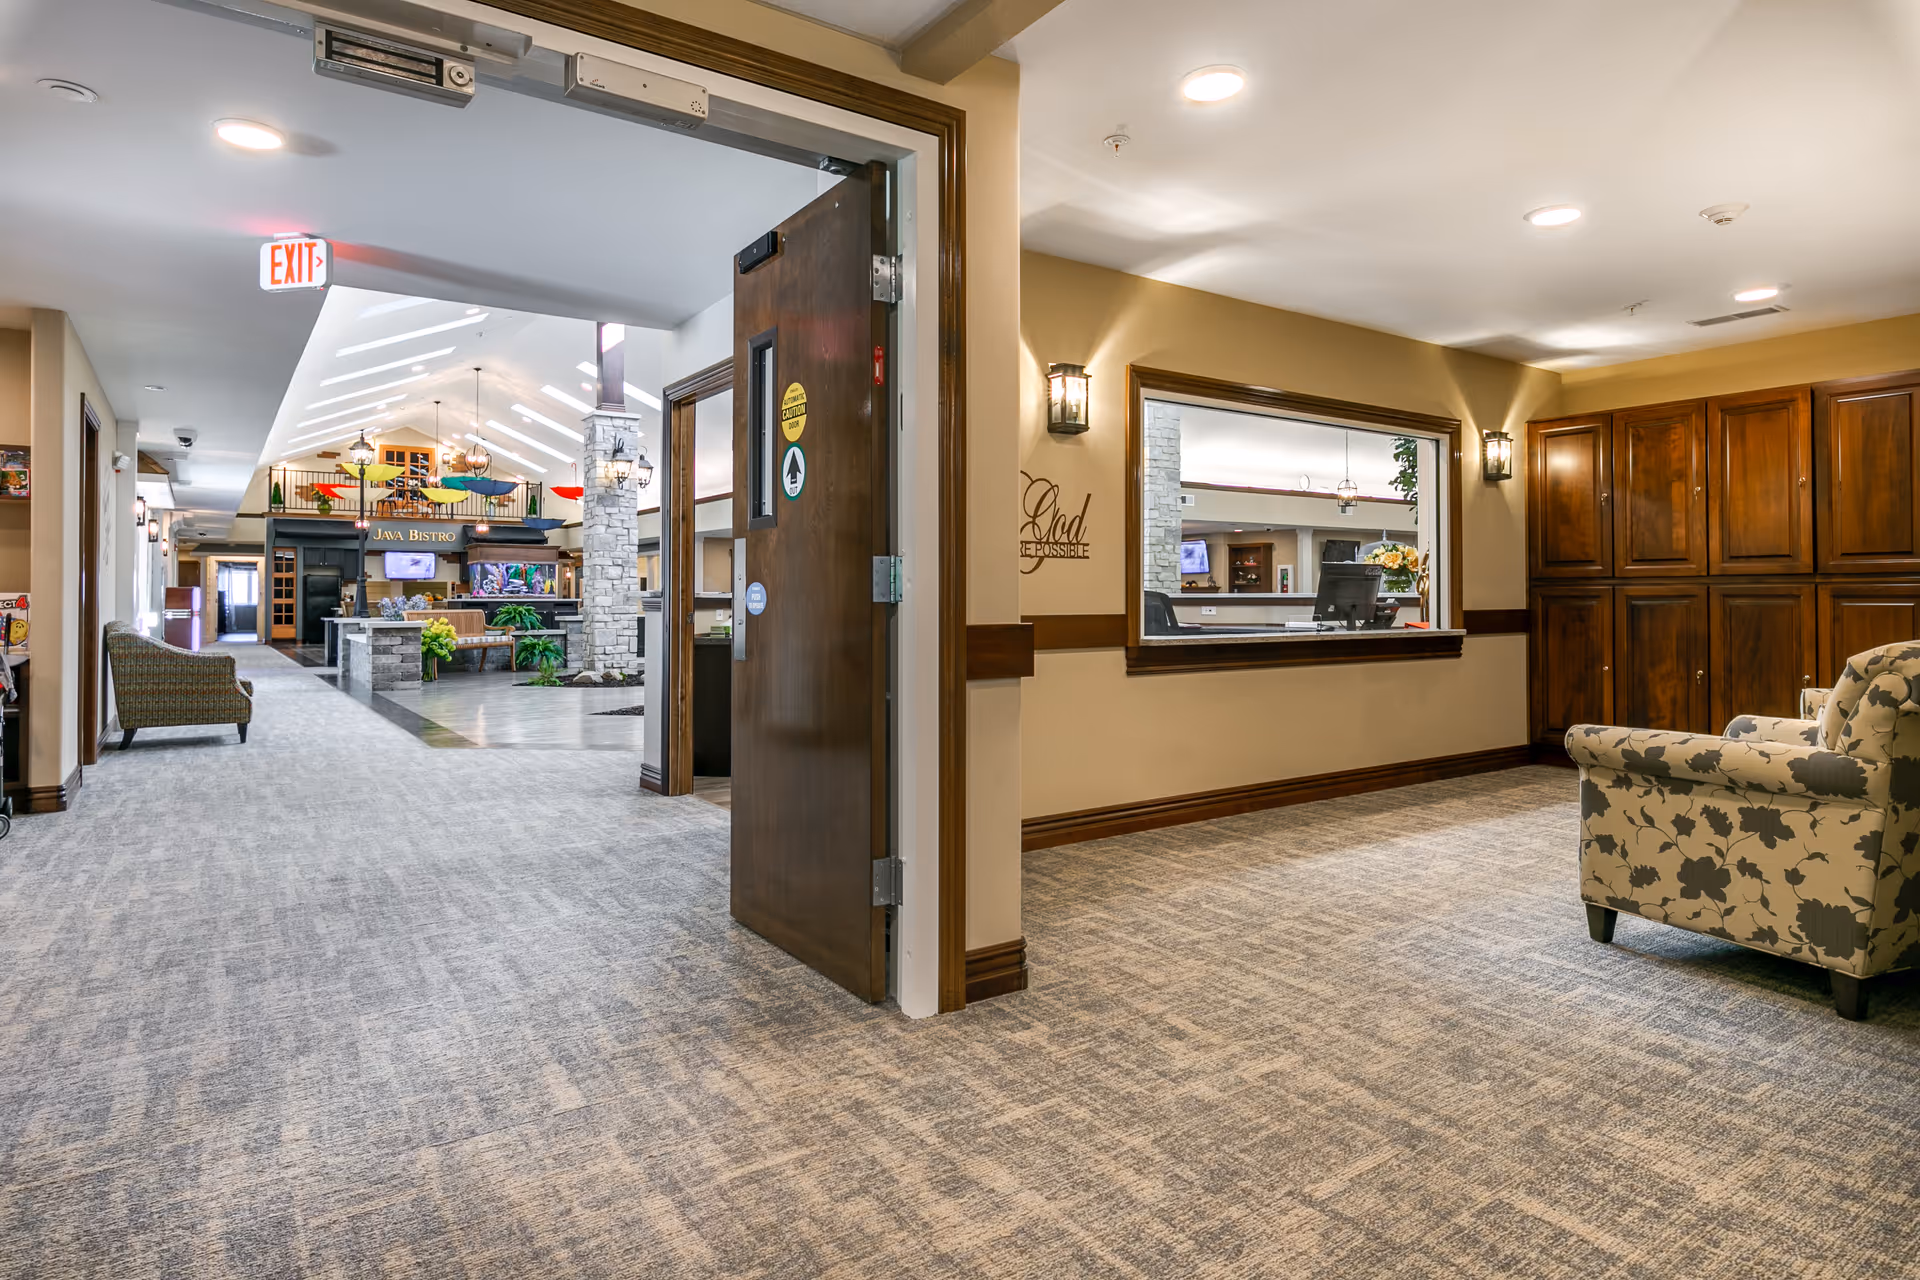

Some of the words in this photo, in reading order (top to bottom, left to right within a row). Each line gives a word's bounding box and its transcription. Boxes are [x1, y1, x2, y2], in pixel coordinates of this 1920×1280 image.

[271, 242, 317, 285] EXIT
[784, 392, 805, 405] AUTOMATIC
[783, 403, 806, 420] CAUTION
[789, 420, 800, 430] DOOR
[789, 486, 798, 495] OUT
[1020, 470, 1092, 572] God
[373, 528, 404, 541] JAVA
[409, 529, 456, 542] BISTRO
[1035, 542, 1090, 558] POSSIBLE
